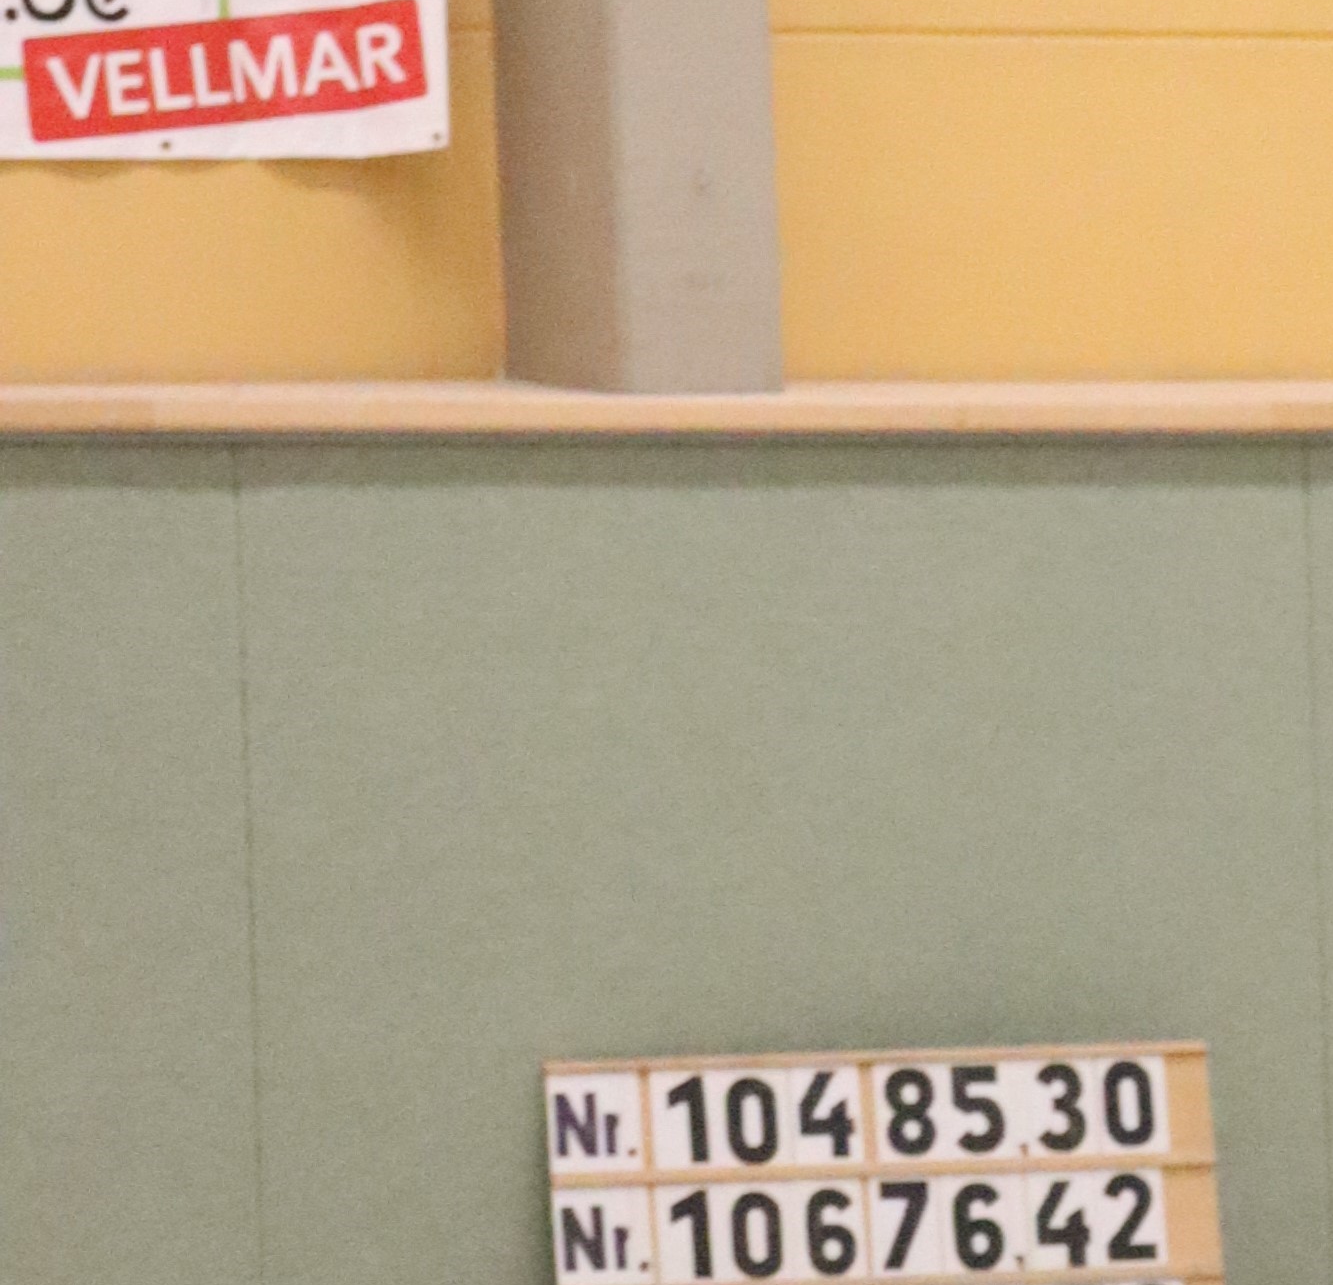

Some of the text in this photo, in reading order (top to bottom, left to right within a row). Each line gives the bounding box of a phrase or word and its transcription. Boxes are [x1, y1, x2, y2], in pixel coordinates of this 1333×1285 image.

[46, 22, 406, 121] VELLMAR
[554, 1092, 637, 1158] Nr.
[667, 1071, 854, 1164] 104
[561, 1205, 649, 1272] Nr.
[669, 1189, 857, 1281] 106
